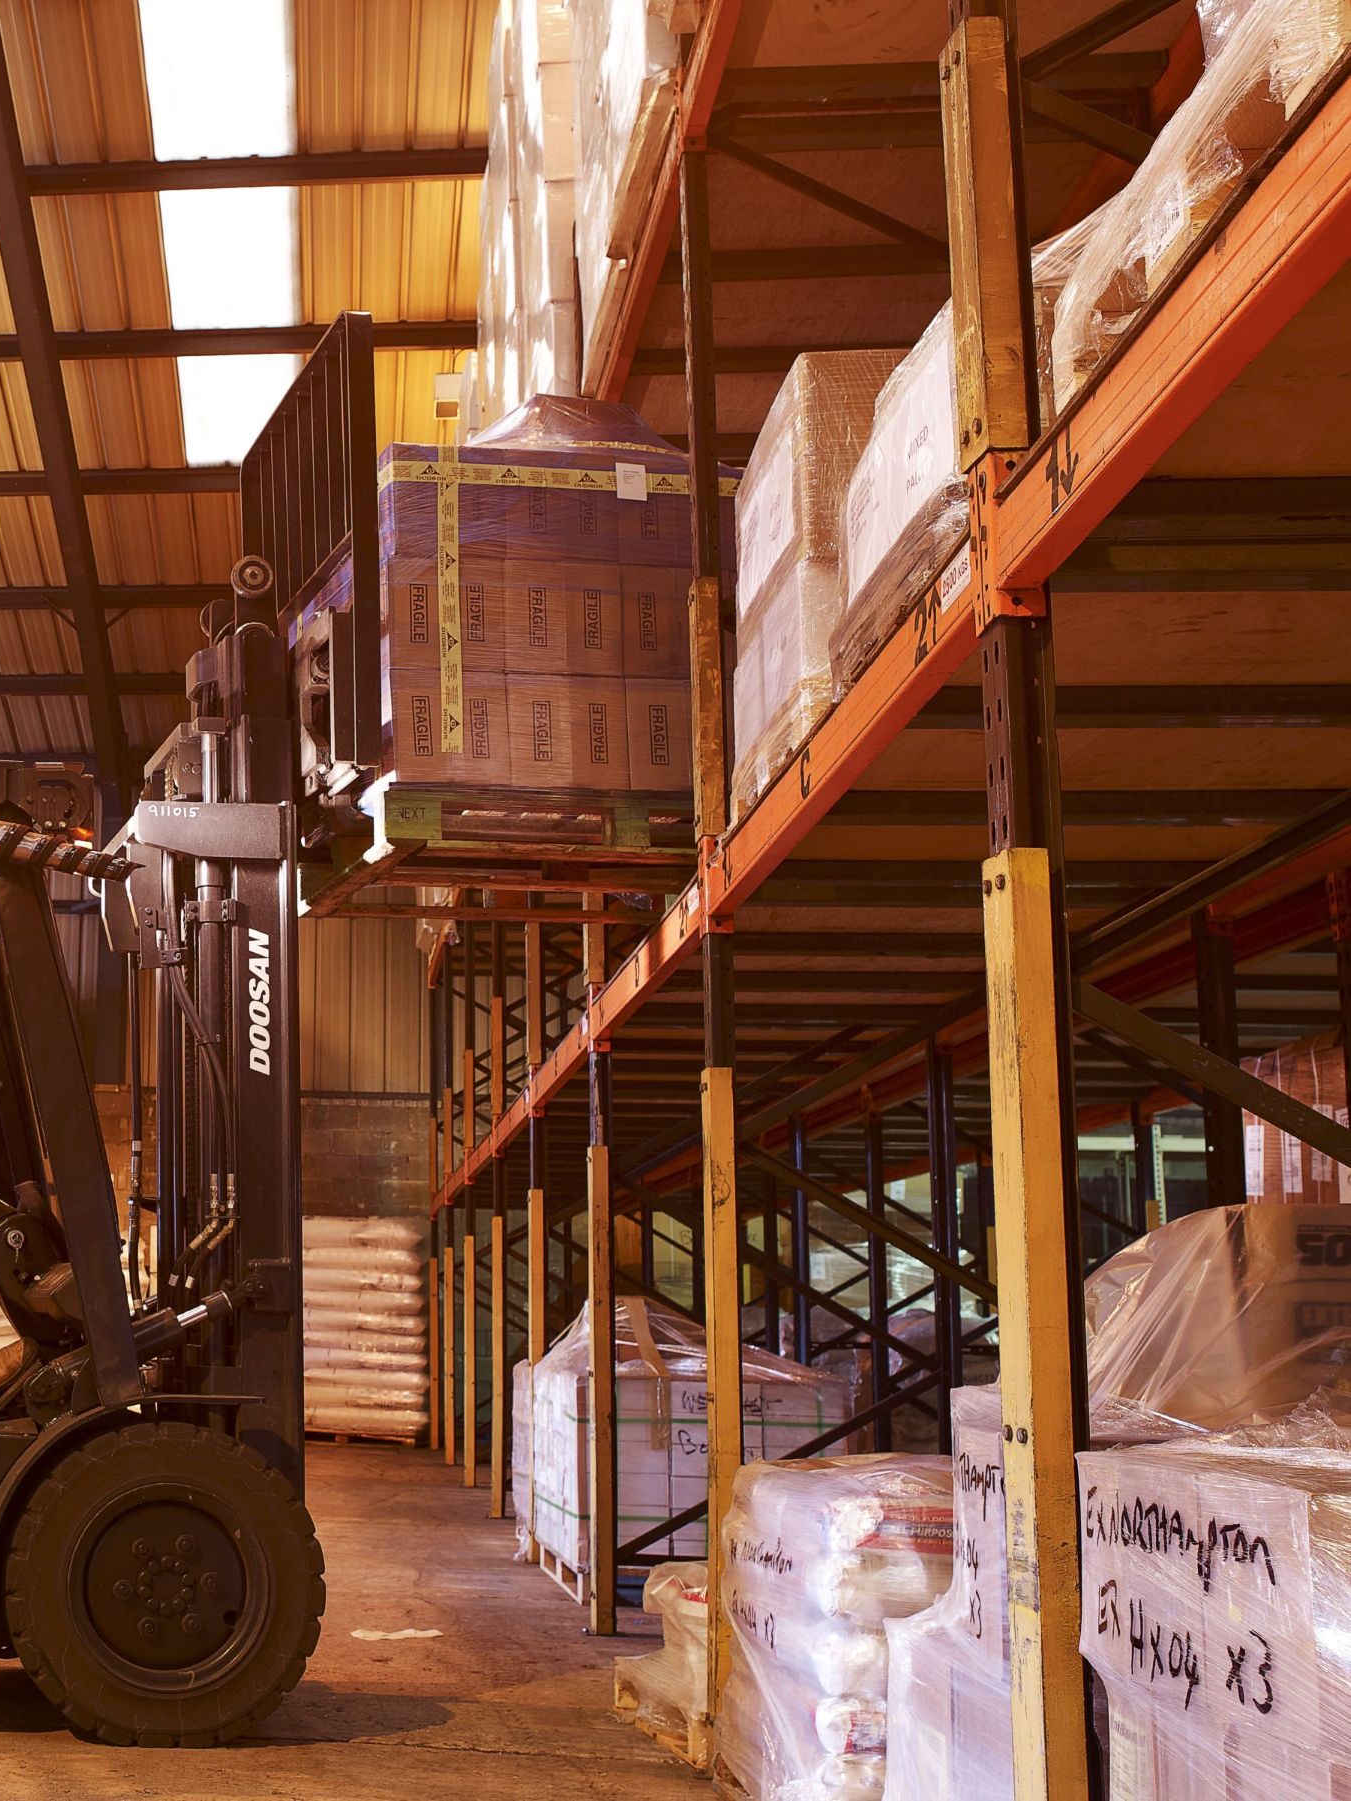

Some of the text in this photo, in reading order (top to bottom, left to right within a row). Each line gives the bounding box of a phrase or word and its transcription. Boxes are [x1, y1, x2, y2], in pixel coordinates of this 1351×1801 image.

[942, 567, 957, 599] 2500
[413, 586, 426, 642] FRAGILE
[469, 585, 482, 640] FRAGILE
[531, 588, 545, 645] FRAGILE
[587, 591, 600, 647] FRAGILE
[641, 594, 655, 649] FRAGILE
[914, 597, 929, 669] 2
[415, 698, 430, 755] FRAGILE
[473, 699, 487, 757] FRAGILE
[536, 703, 550, 760] FRAGILE
[592, 707, 606, 762] FRAGILE
[652, 706, 667, 763] FRAGILE
[148, 804, 200, 819] 911015
[249, 929, 271, 1076] DOOSAN
[910, 1527, 953, 1538] PURPOS
